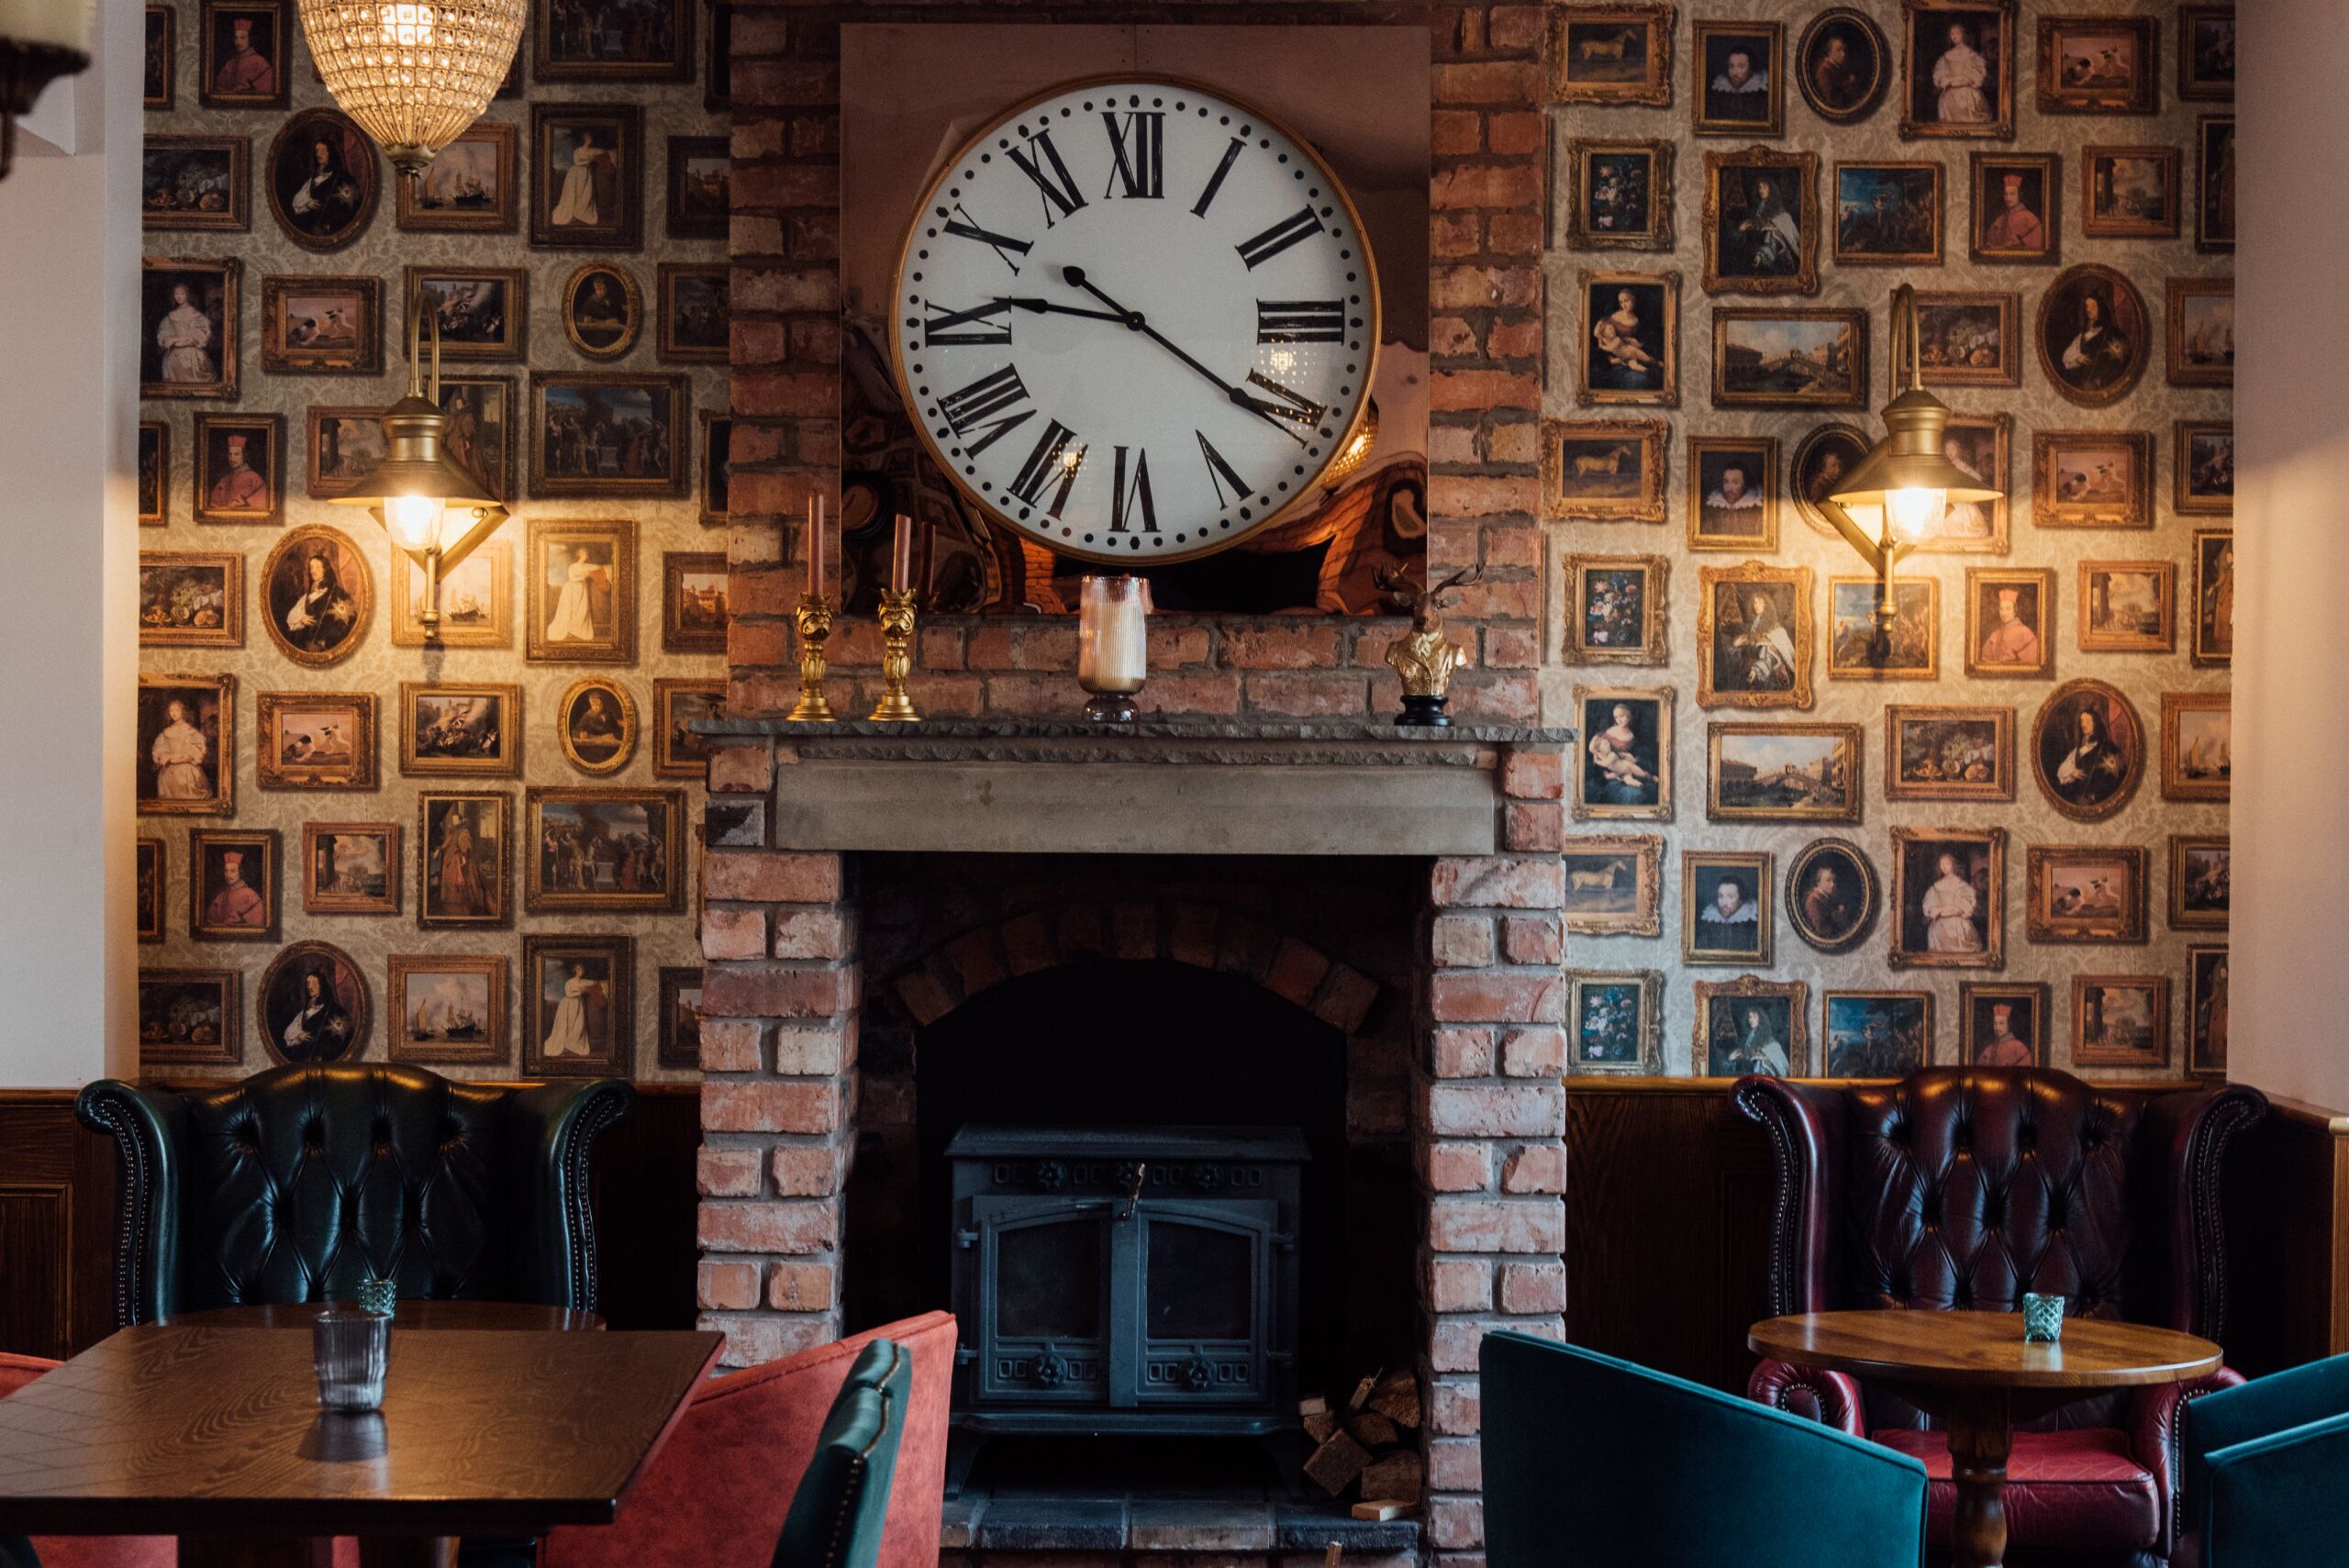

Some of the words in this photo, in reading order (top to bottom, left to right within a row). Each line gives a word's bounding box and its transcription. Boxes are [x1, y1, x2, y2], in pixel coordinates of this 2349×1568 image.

[1006, 128, 1088, 228] XI
[1101, 112, 1166, 199] XII
[1190, 137, 1246, 218] I
[943, 203, 1034, 275] X
[1235, 204, 1325, 272] II
[925, 295, 1013, 347] IX
[1257, 296, 1345, 345] III
[937, 362, 1037, 461] VIII
[1006, 418, 1088, 520] VII
[1108, 446, 1160, 532] VI
[1196, 429, 1254, 509] V
